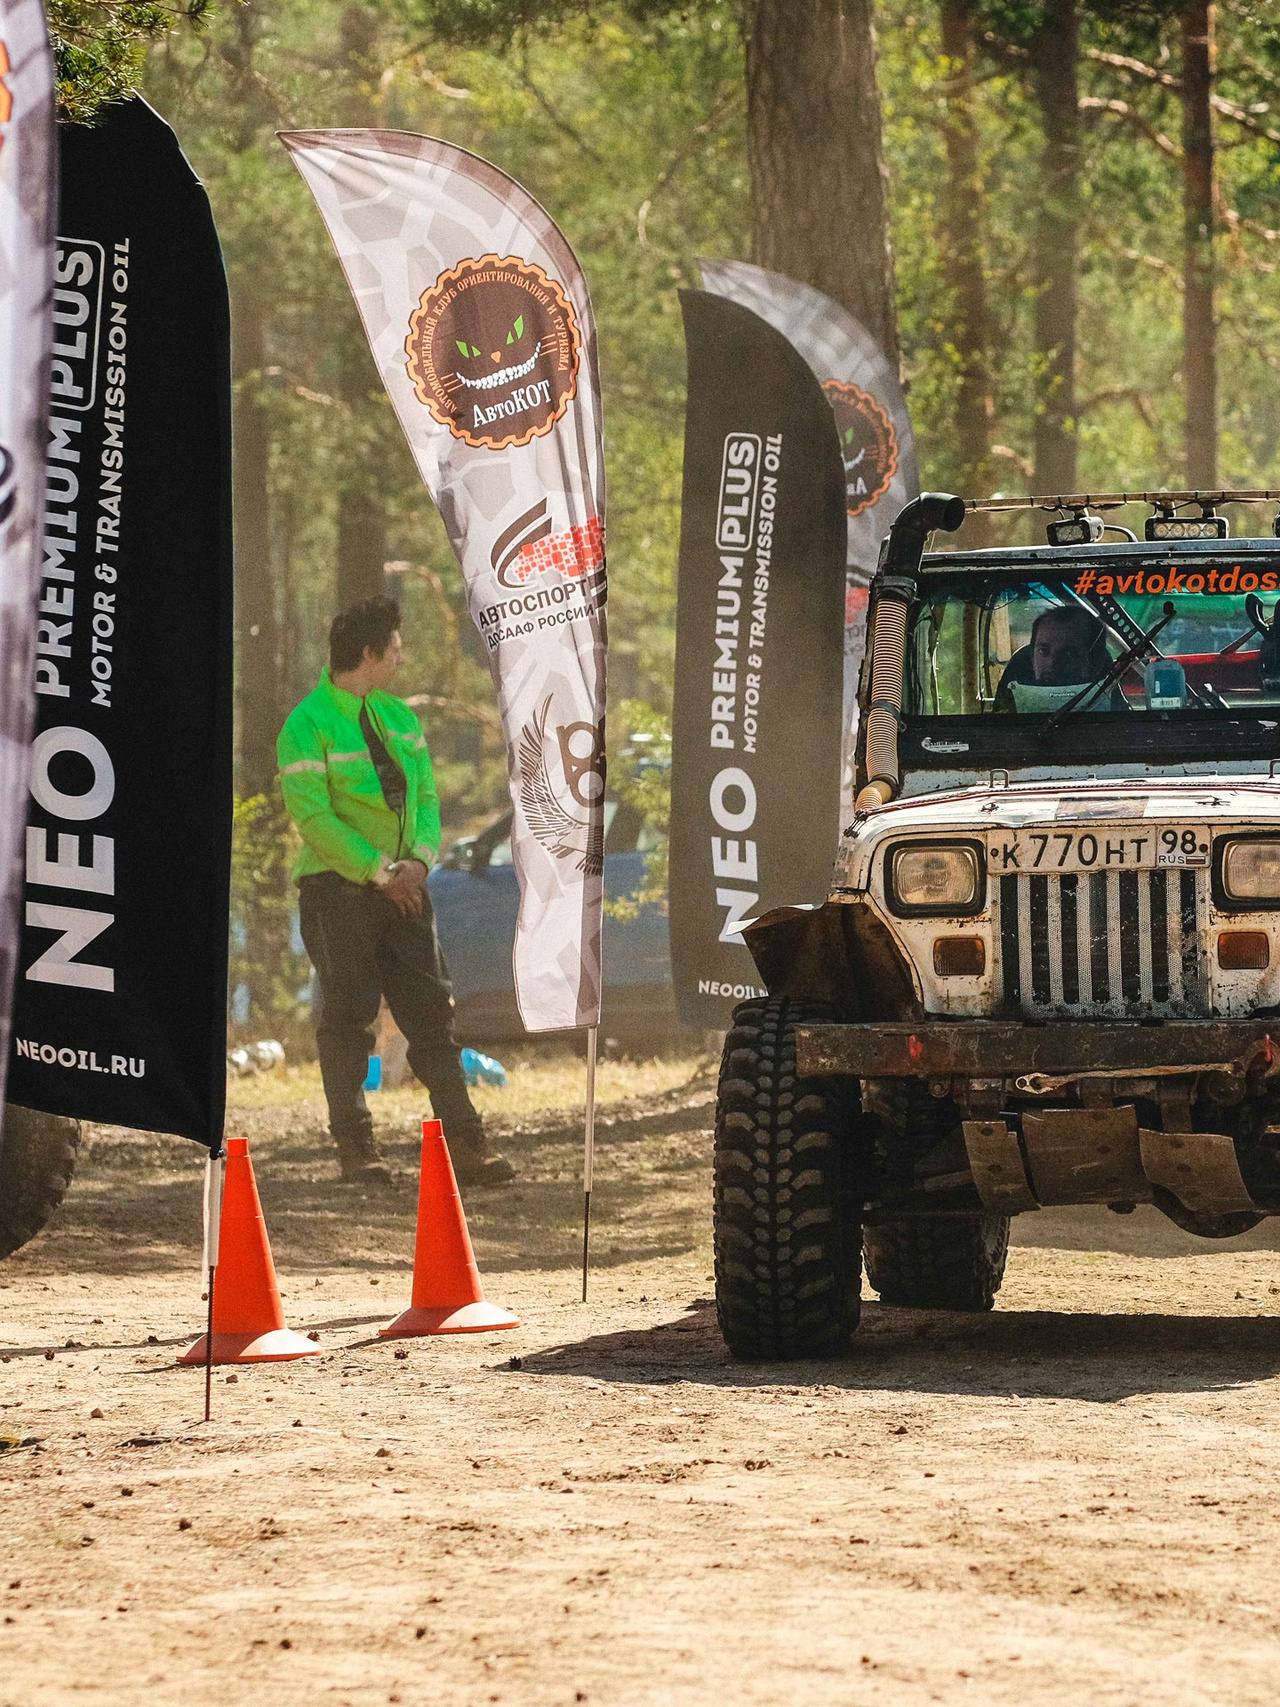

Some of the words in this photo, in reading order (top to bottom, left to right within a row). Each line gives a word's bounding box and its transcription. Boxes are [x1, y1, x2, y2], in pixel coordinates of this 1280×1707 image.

[112, 238, 130, 293] OIL
[456, 271, 550, 305] ОРИЕНТИРОВАНИЯ
[52, 250, 94, 400] PLUS
[432, 288, 458, 316] КЛУБ
[546, 302, 559, 315] И
[421, 317, 457, 414] АВТОМОБИЛЬНЫЙ
[553, 315, 570, 372] ТУРИЗМА
[95, 302, 128, 553] TRANSMISSION
[764, 433, 783, 472] OIL
[720, 440, 756, 544] PLUS
[34, 416, 82, 698] PREMIUM
[94, 563, 118, 584] &
[749, 476, 778, 649] TRANSMISSION
[478, 579, 587, 629] АВТОСПОРТ
[487, 621, 535, 650] ДОСААФ
[538, 604, 595, 630] РОССИИ
[90, 593, 116, 708] MOTOR
[710, 556, 744, 749] PREMIUM
[747, 653, 763, 669] &
[743, 673, 761, 754] MOTOR
[26, 726, 116, 993] NEO
[709, 766, 760, 946] NEO
[1002, 833, 1149, 869] К770НТ
[1158, 854, 1186, 865] RUS
[1161, 829, 1197, 855] 98
[15, 1037, 146, 1079] NEOOIL.RU
